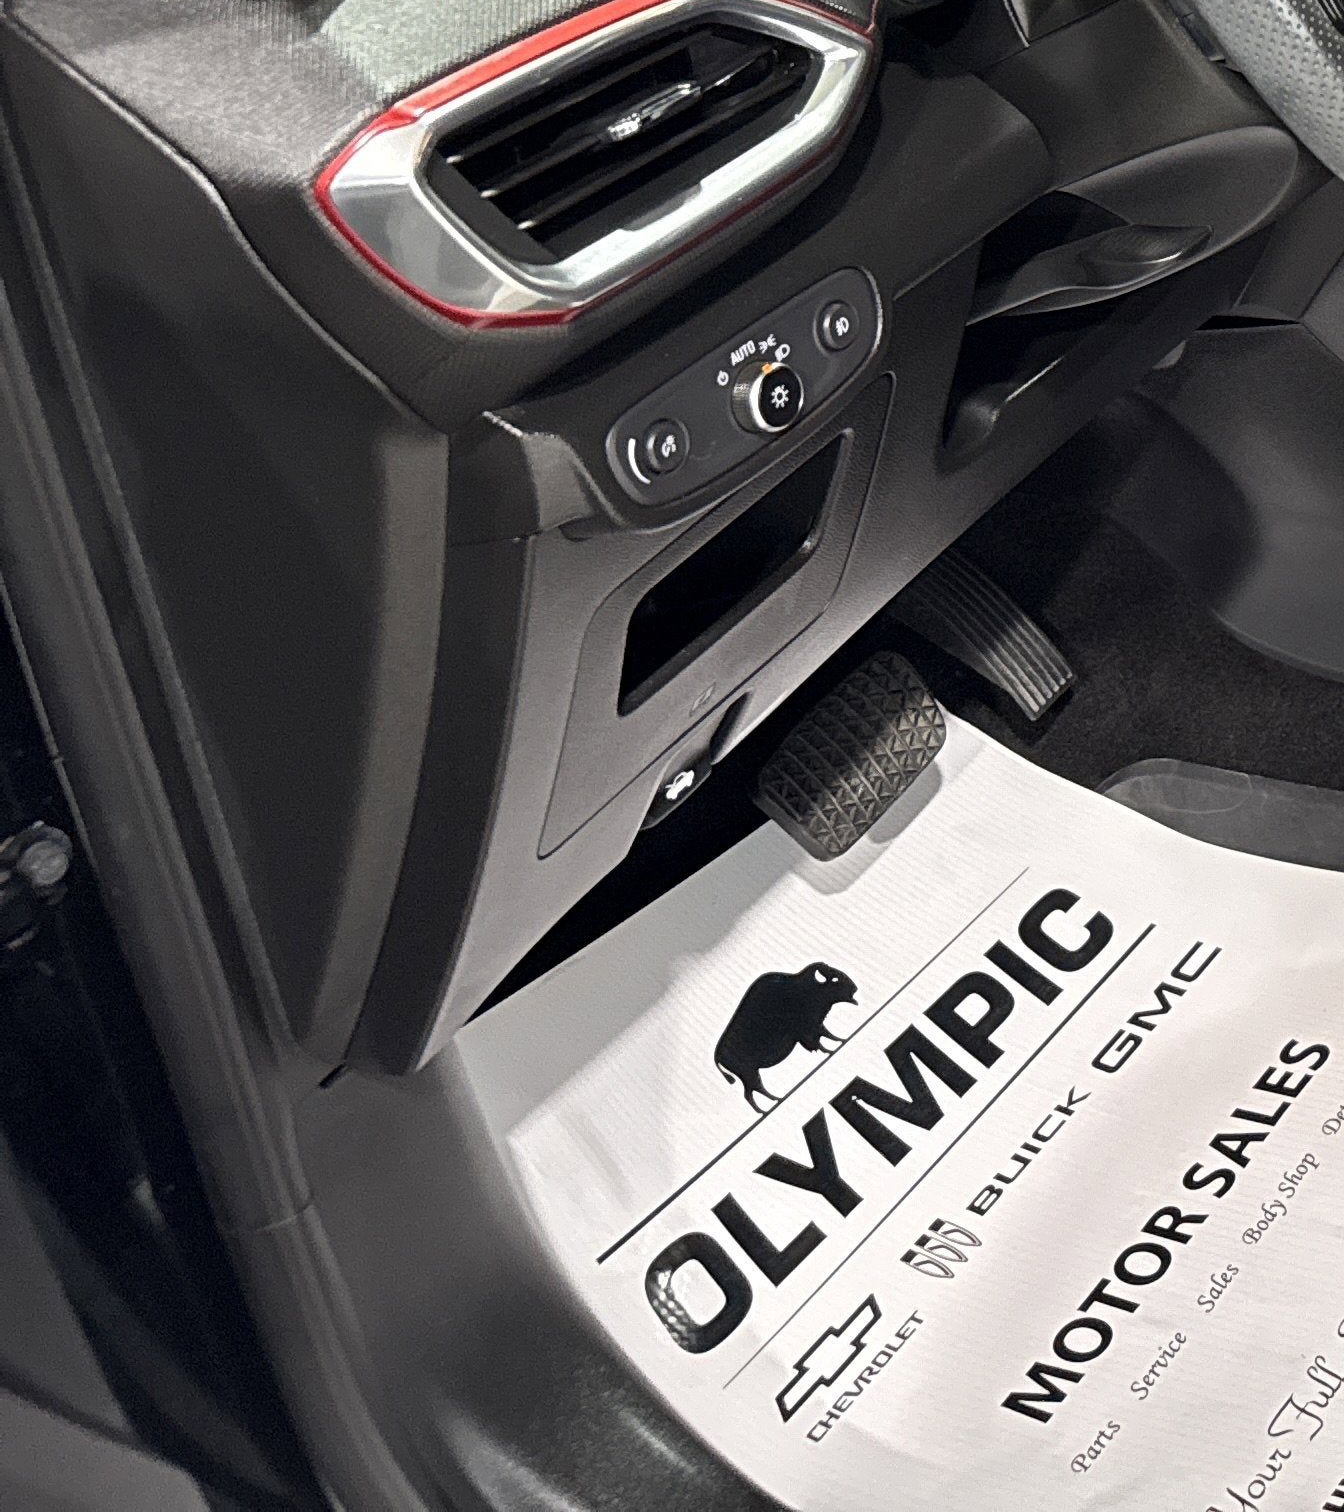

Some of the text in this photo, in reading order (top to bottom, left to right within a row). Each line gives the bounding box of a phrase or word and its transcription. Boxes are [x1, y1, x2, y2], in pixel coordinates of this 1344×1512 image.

[730, 340, 756, 366] AUTO
[645, 888, 1114, 1354] OLYMPIC
[966, 941, 1222, 1217] BUICK GMC
[806, 1310, 924, 1443] CHEVROLET
[1000, 1038, 1331, 1424] MOTOR SALES
[1070, 1418, 1121, 1475] Parts
[1130, 1330, 1187, 1401] Service
[1197, 1262, 1240, 1314] Sales
[1242, 1193, 1288, 1247] Body
[1278, 1151, 1320, 1210] Shop
